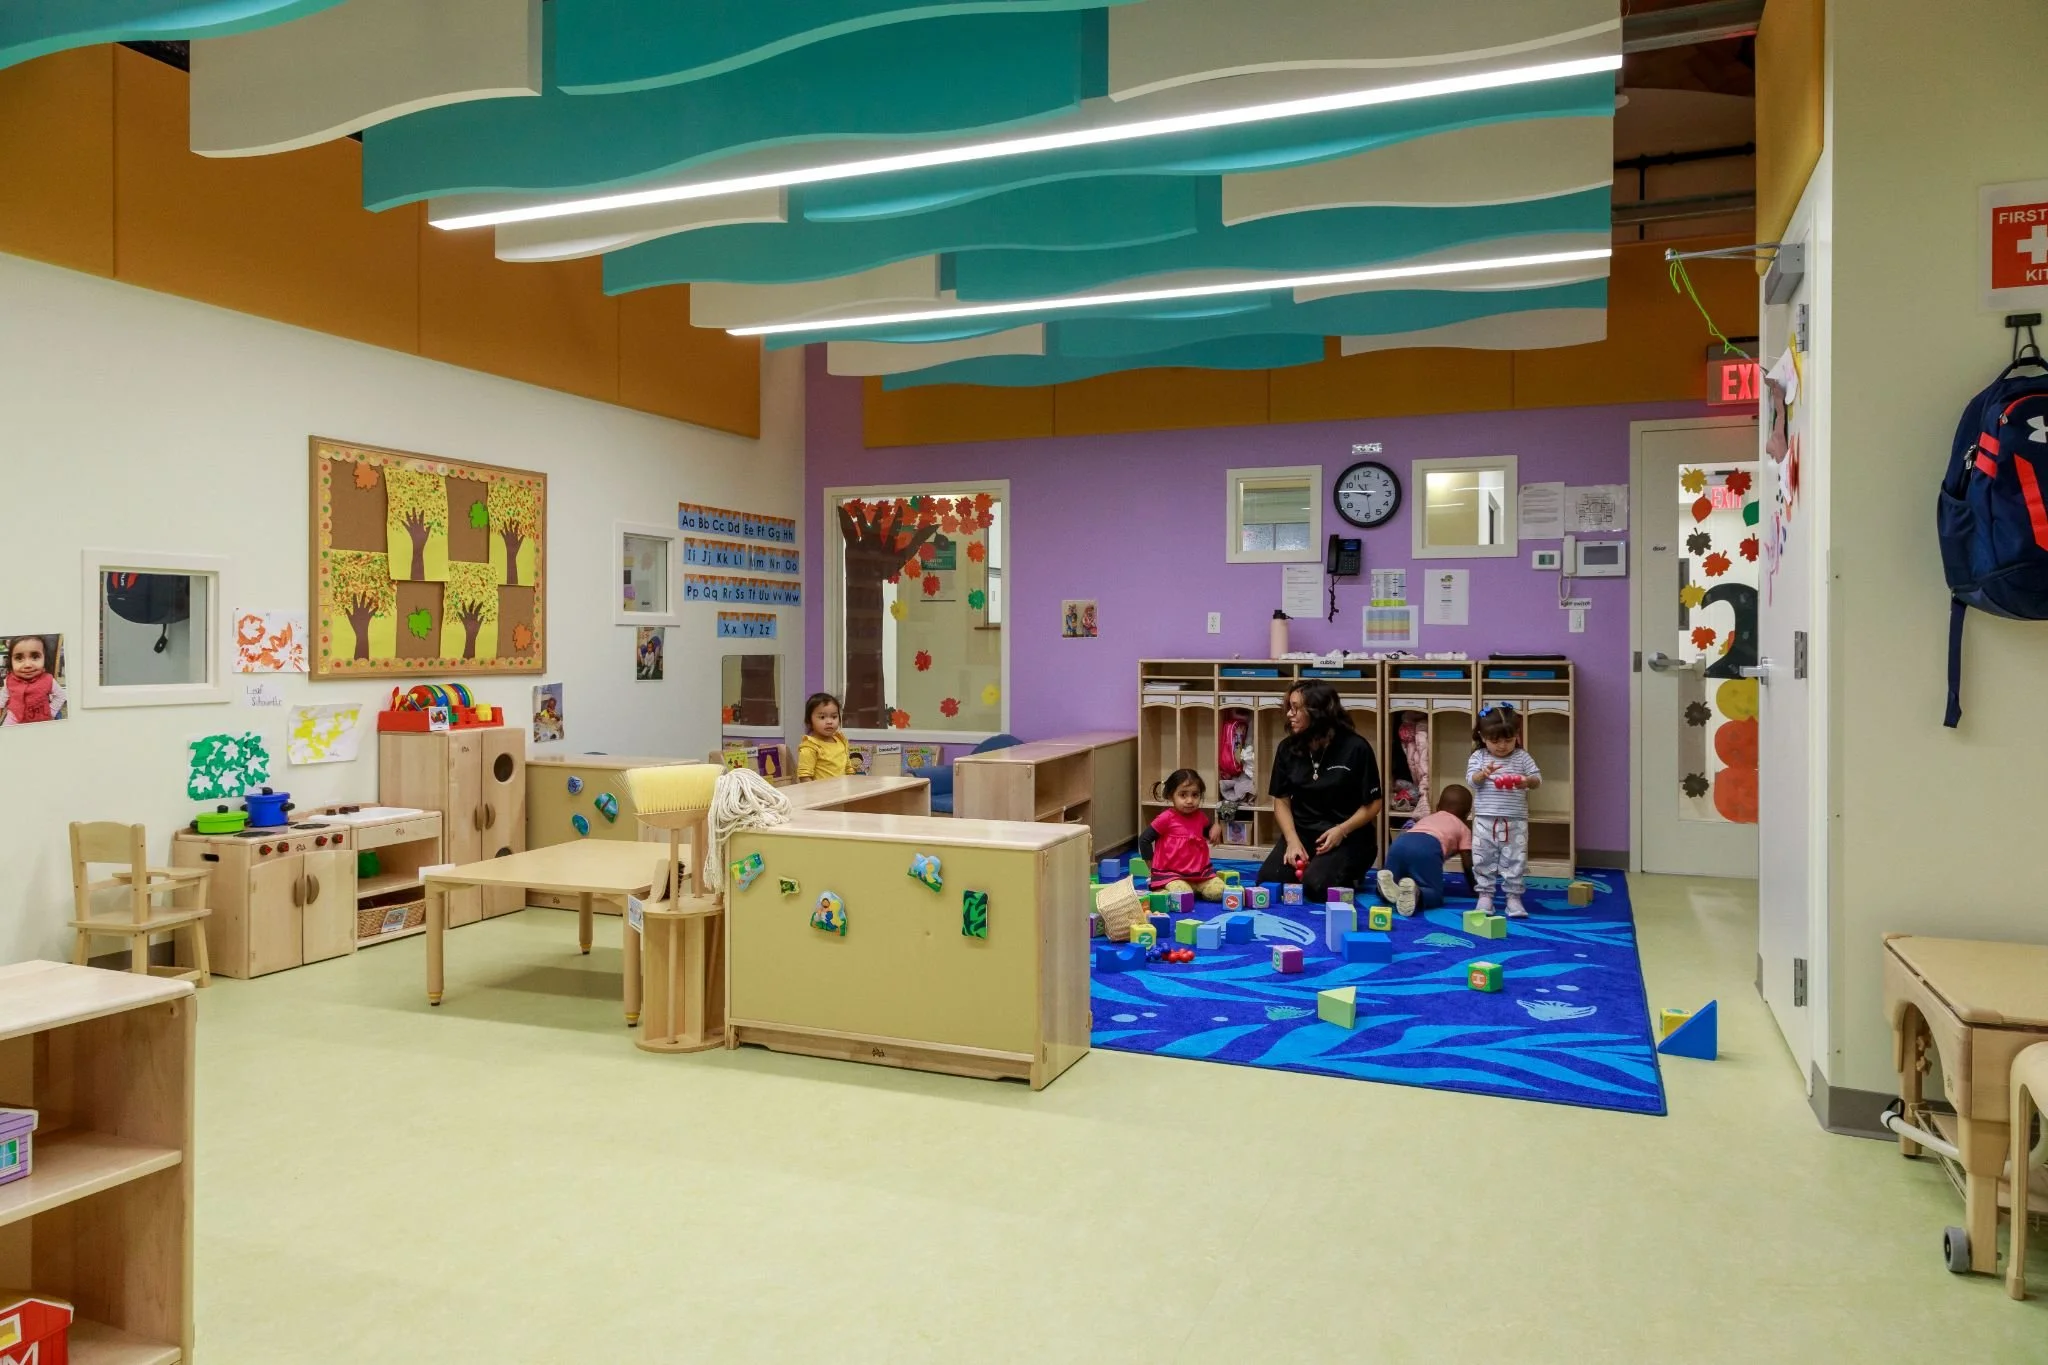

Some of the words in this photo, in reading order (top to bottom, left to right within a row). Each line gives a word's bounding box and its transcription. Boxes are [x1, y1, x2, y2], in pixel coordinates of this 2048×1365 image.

[1999, 209, 2048, 224] FIRST
[1722, 364, 1759, 400] EXI
[682, 516, 695, 528] Aa
[698, 517, 710, 530] Bb
[712, 519, 724, 532] Cc
[728, 522, 740, 534] Dd
[744, 525, 754, 536] Ee
[757, 526, 764, 536] Ff
[768, 527, 780, 540] Gg
[783, 530, 793, 540] Hh
[687, 548, 696, 562] Ii
[702, 550, 711, 566] Jj
[716, 552, 728, 564] Kk
[734, 554, 742, 565] Ll
[770, 558, 780, 569] Nn
[786, 560, 797, 571] Oo
[687, 586, 699, 599] Pp
[703, 586, 718, 600] Qq
[722, 588, 732, 598] Rr
[735, 588, 744, 600] Ss
[748, 588, 756, 600] Tt
[759, 590, 770, 600] Uu
[773, 590, 782, 601] Vv
[785, 592, 799, 602] Ww
[724, 623, 737, 634] Xx
[743, 624, 754, 636] Yy
[759, 624, 770, 635] Zz
